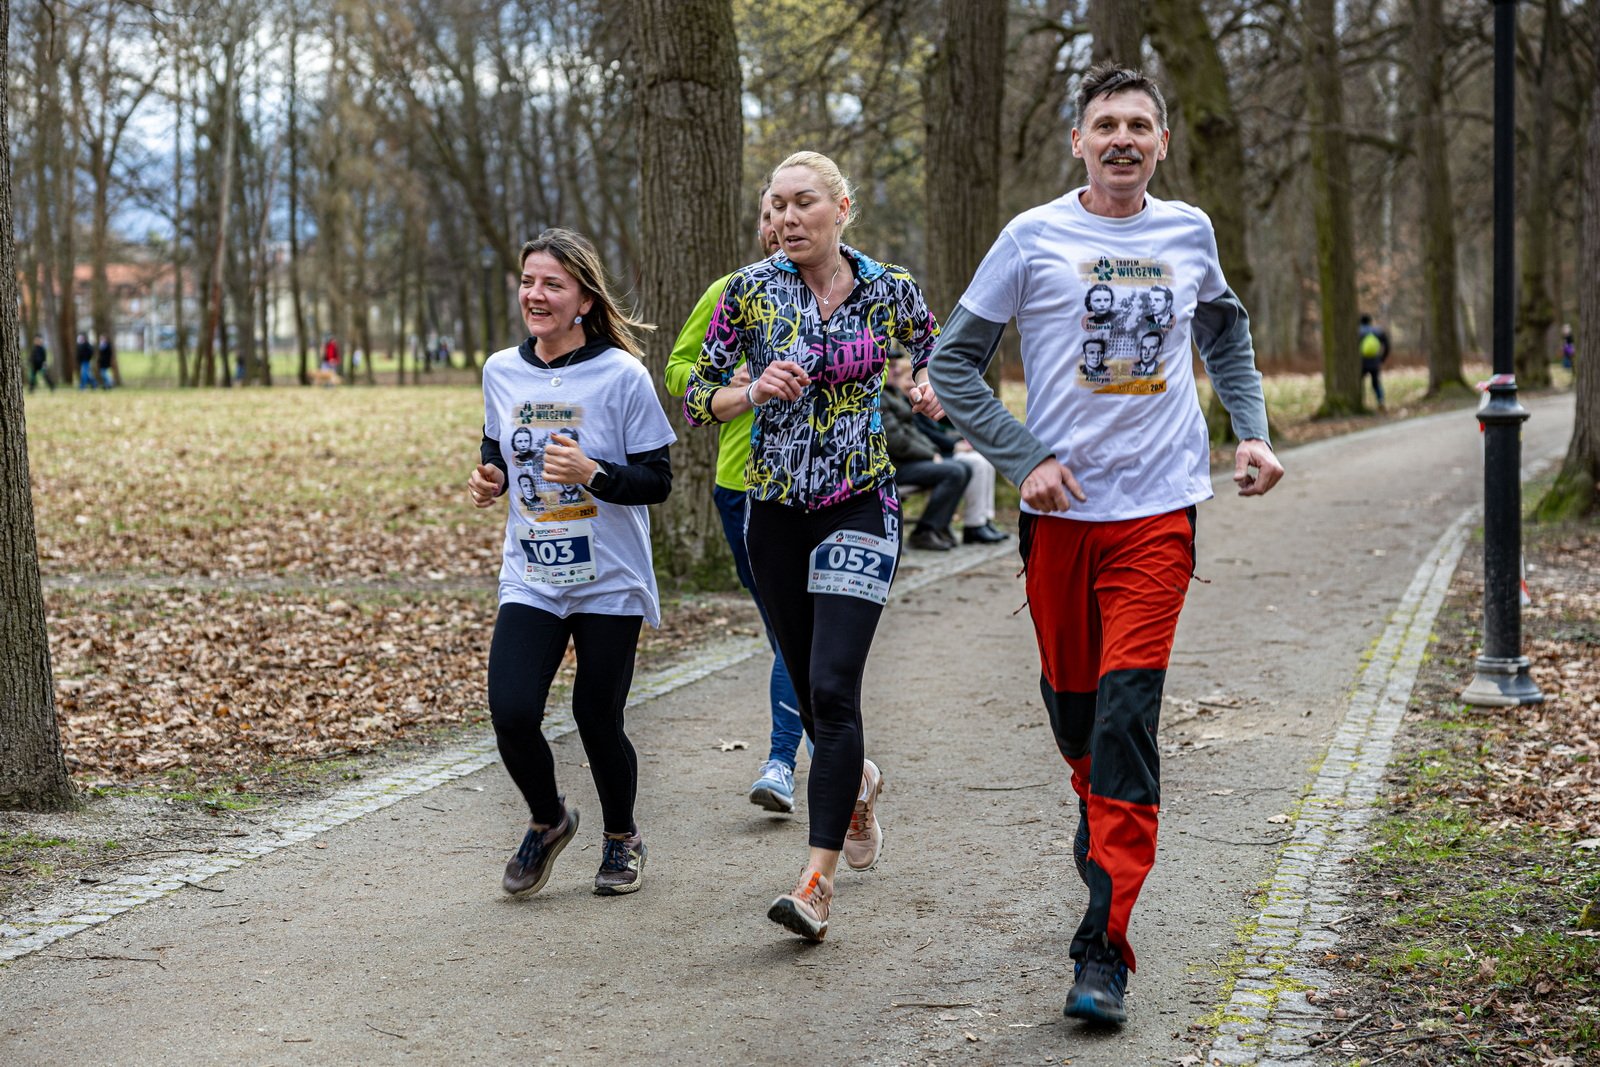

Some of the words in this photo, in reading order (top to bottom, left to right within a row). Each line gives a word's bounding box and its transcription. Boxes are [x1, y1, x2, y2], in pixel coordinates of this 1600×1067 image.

[1117, 267, 1162, 278] WILCZYM
[536, 410, 572, 419] WILCZYM
[529, 540, 575, 565] 103
[828, 546, 881, 577] 052
